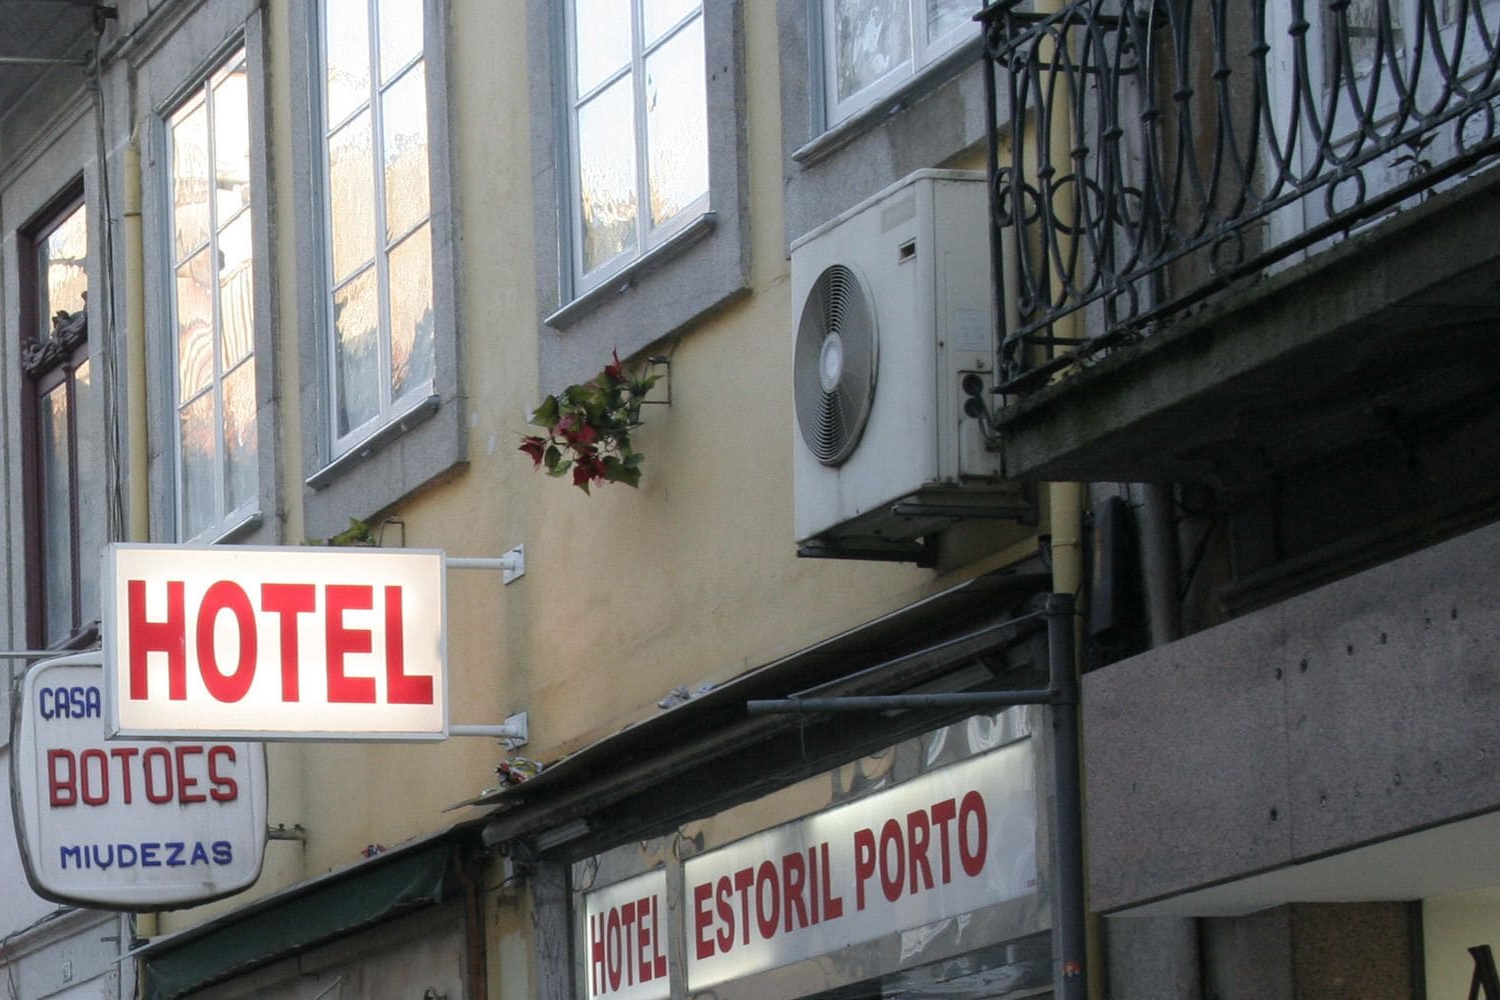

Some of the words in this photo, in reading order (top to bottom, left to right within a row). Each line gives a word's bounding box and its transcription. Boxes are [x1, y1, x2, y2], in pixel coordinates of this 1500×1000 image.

[127, 579, 434, 705] HOTEL
[39, 686, 101, 719] CASA
[47, 744, 238, 808] BOTOES
[59, 841, 234, 870] MIUDEZAS
[693, 841, 843, 961] ESTORIL
[854, 790, 989, 912] PORTO
[589, 894, 668, 998] HOTEL
